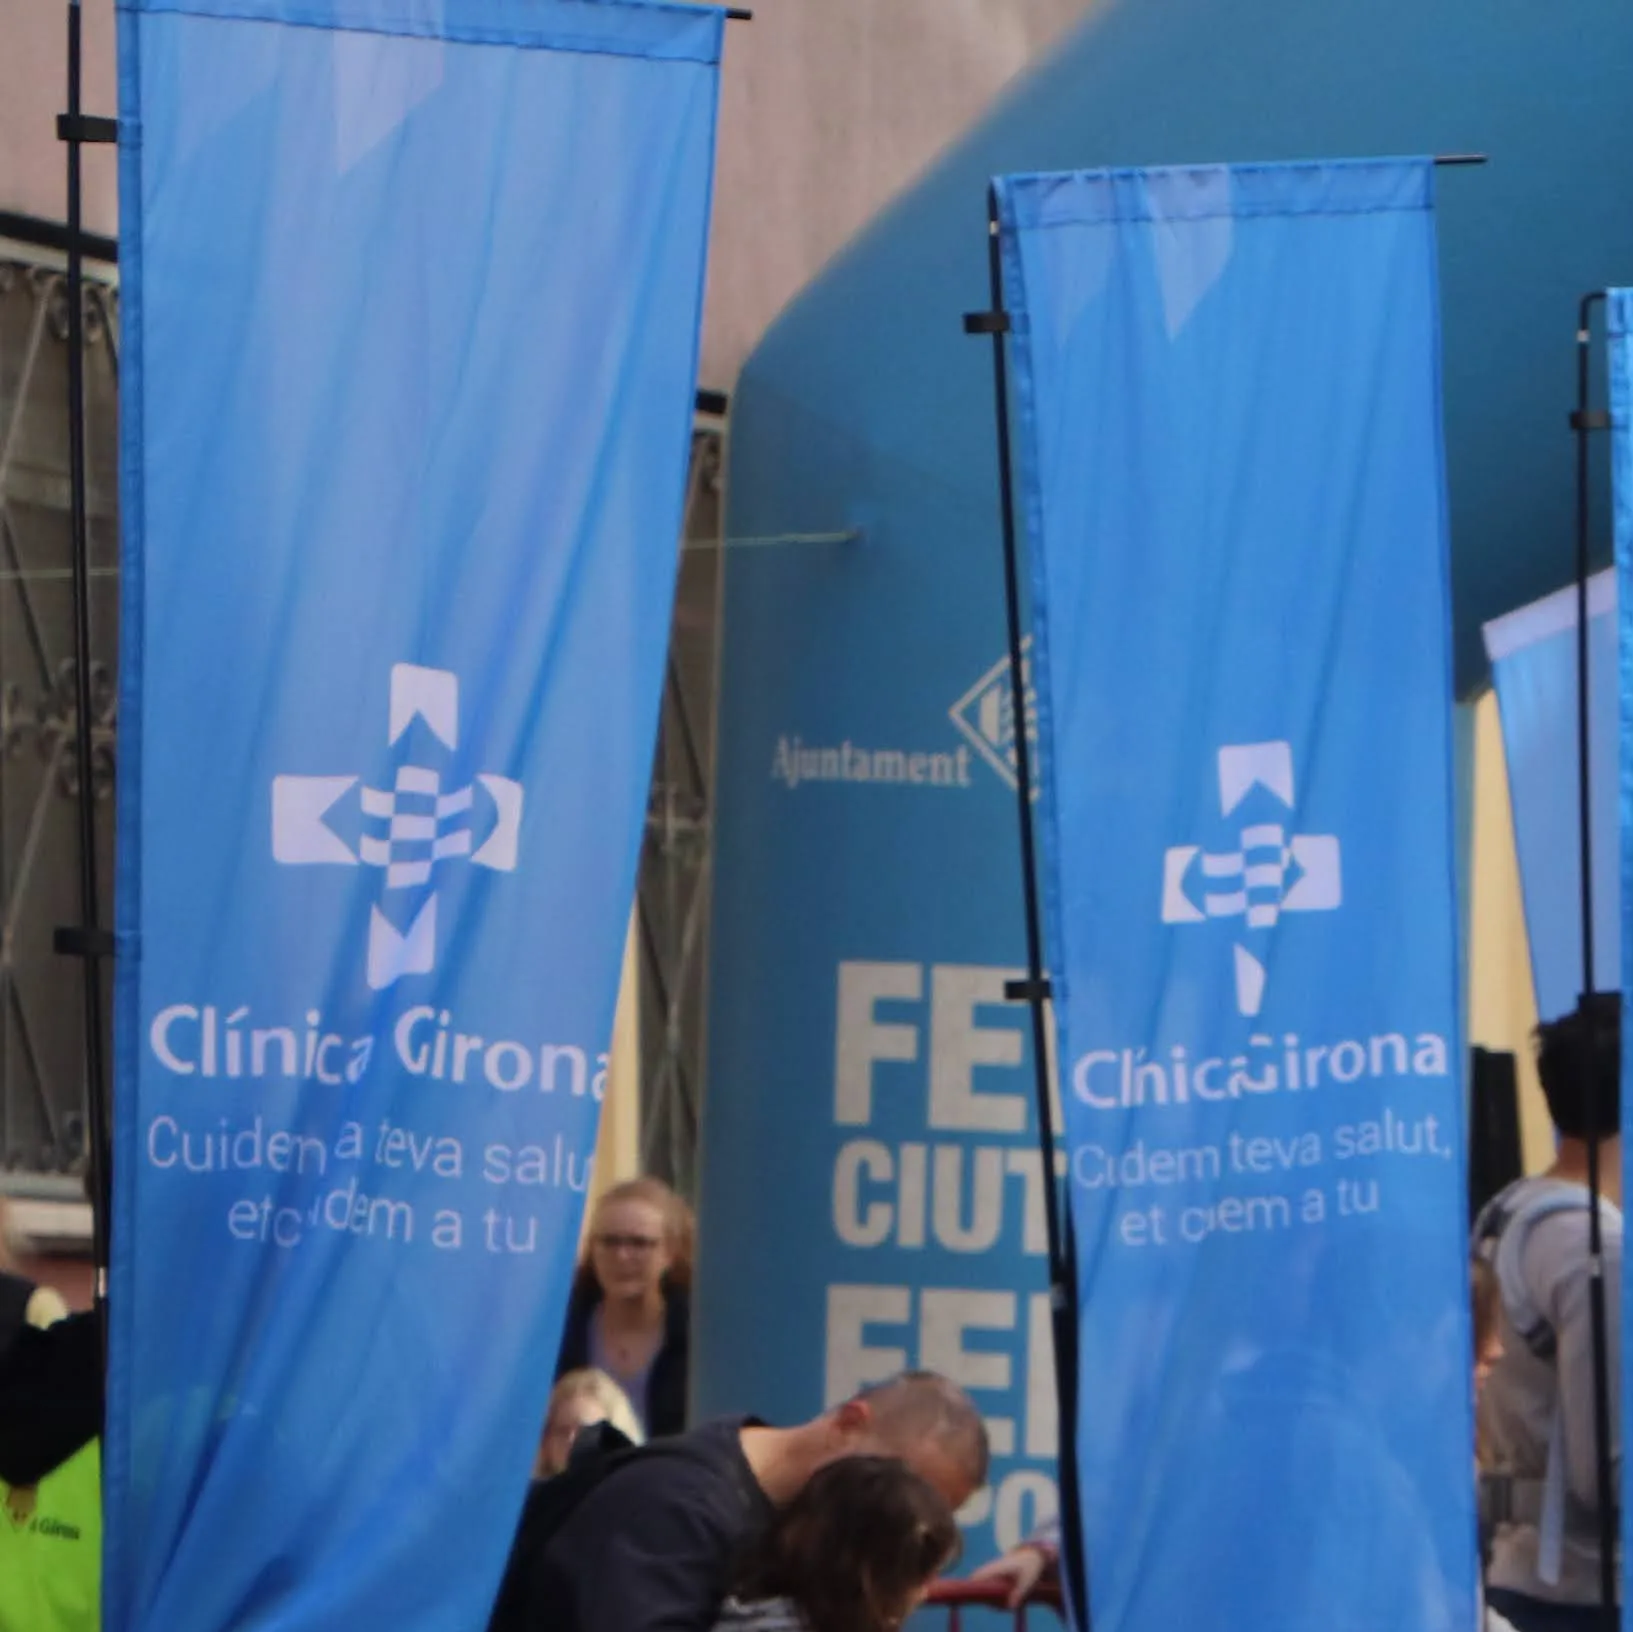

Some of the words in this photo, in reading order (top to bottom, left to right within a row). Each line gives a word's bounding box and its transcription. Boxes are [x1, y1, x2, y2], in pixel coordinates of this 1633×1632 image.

[770, 735, 972, 790] Ajuntament
[335, 1120, 364, 1161] a
[376, 1117, 464, 1179] teva
[1074, 1139, 1222, 1190] Cdem
[1230, 1129, 1322, 1174] teva
[1334, 1107, 1452, 1161] salut,
[228, 1194, 271, 1242] et
[274, 1177, 413, 1248] cdem
[432, 1209, 463, 1250] a
[483, 1207, 538, 1253] tu
[1121, 1204, 1167, 1247] et
[1302, 1187, 1325, 1224] a
[1338, 1179, 1379, 1217] tu
